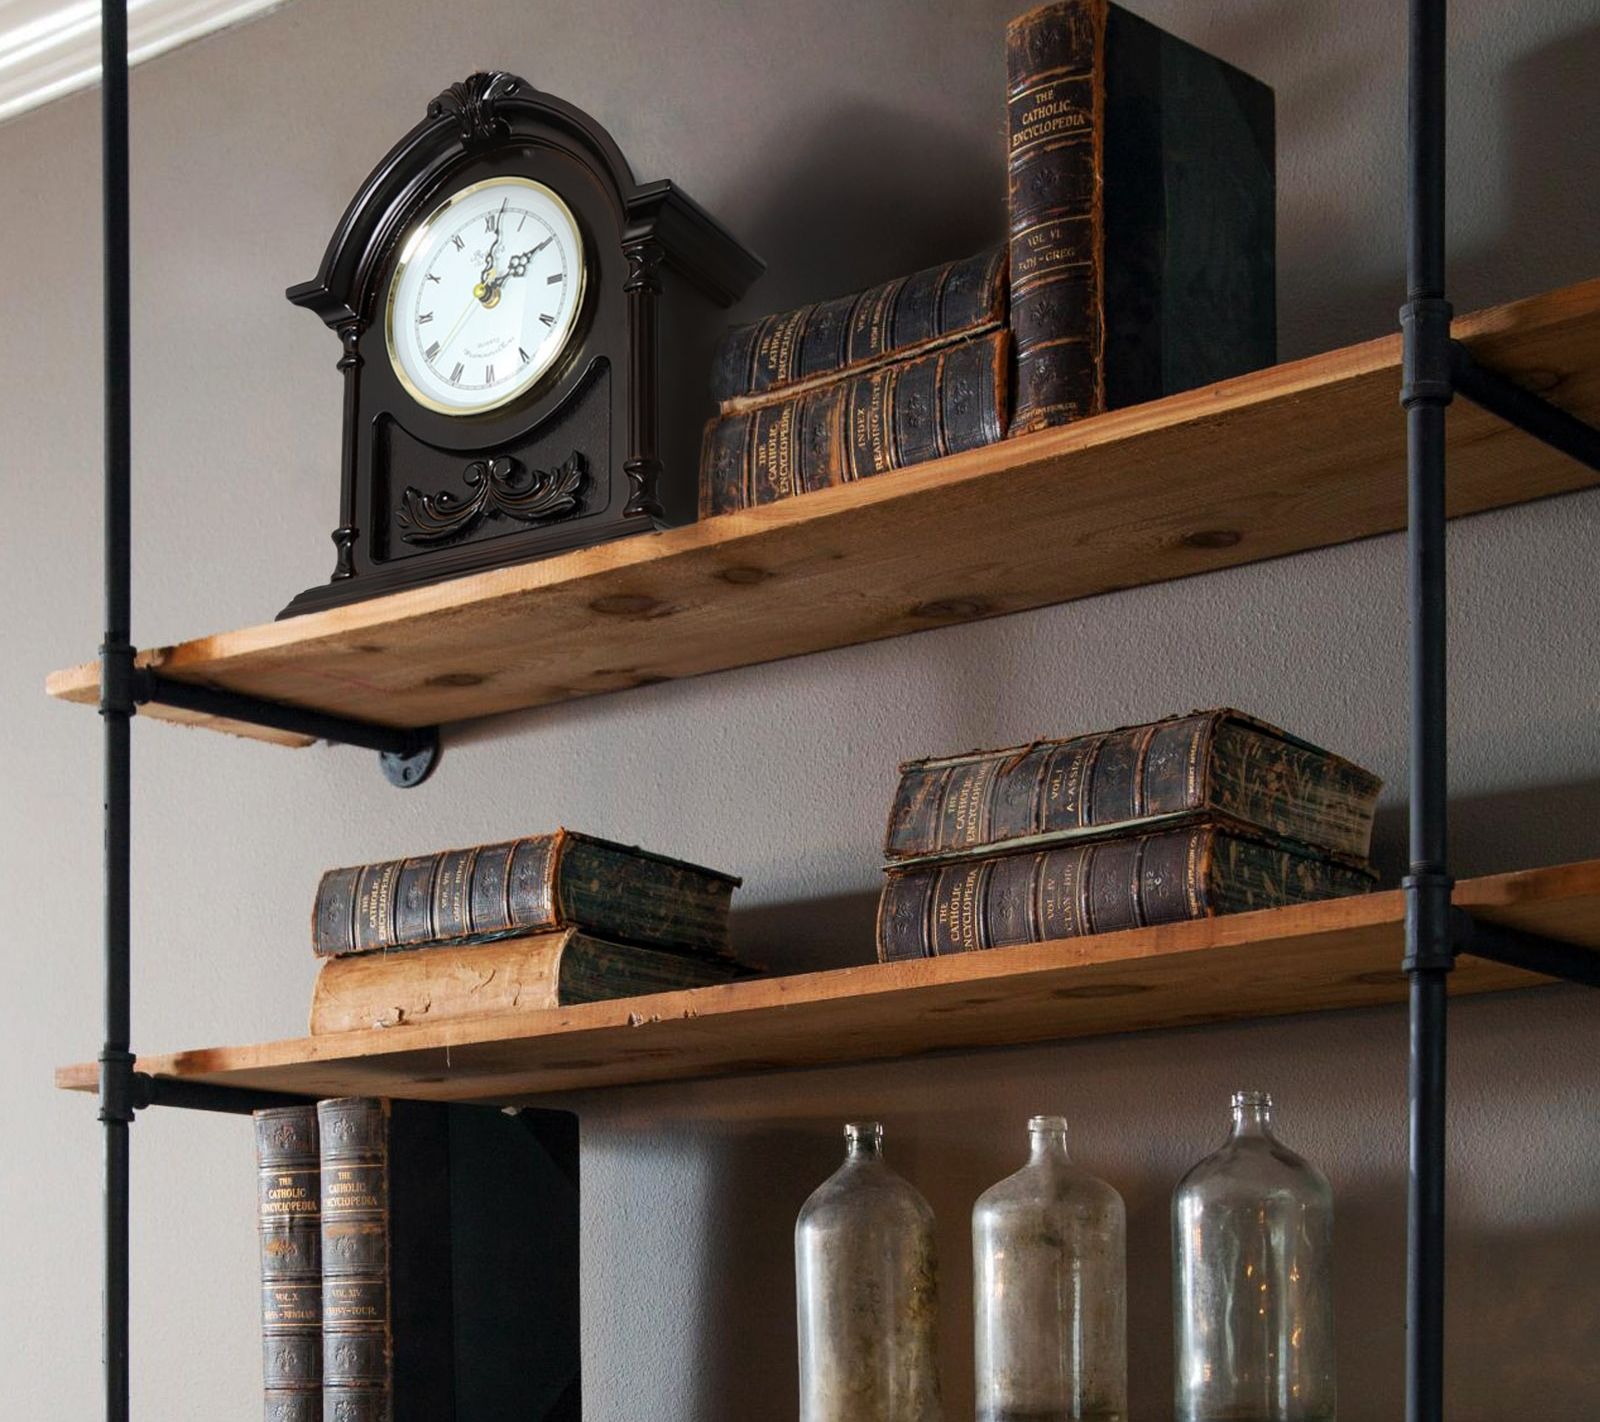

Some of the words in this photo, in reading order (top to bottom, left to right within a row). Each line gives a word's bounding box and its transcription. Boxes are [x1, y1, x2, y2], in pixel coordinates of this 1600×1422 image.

[1035, 89, 1054, 104] THE
[1021, 100, 1071, 125] CATHOLIC
[1012, 113, 1086, 147] ENCYCLOPEDIA
[427, 273, 441, 284] X
[857, 407, 866, 448] INDEX
[768, 423, 779, 481] CATHOLIC
[779, 406, 792, 494] ENCYCLOPEDIA
[871, 414, 884, 471] READING
[758, 444, 767, 465] THE
[956, 776, 974, 830] CATHOLIC
[369, 881, 380, 928] CATHOLIC
[378, 866, 392, 940] ENCYCLOPEDIA
[939, 902, 948, 922] THE
[950, 883, 962, 941] CATHOLIC
[278, 1177, 292, 1186] THE
[338, 1171, 352, 1180] THE
[268, 1188, 306, 1200] CATHOLIC
[328, 1182, 367, 1194] CATHOLIC
[261, 1200, 317, 1213] ENCYCLOPEDIA
[324, 1195, 377, 1207] ENCYCLOPEDIA
